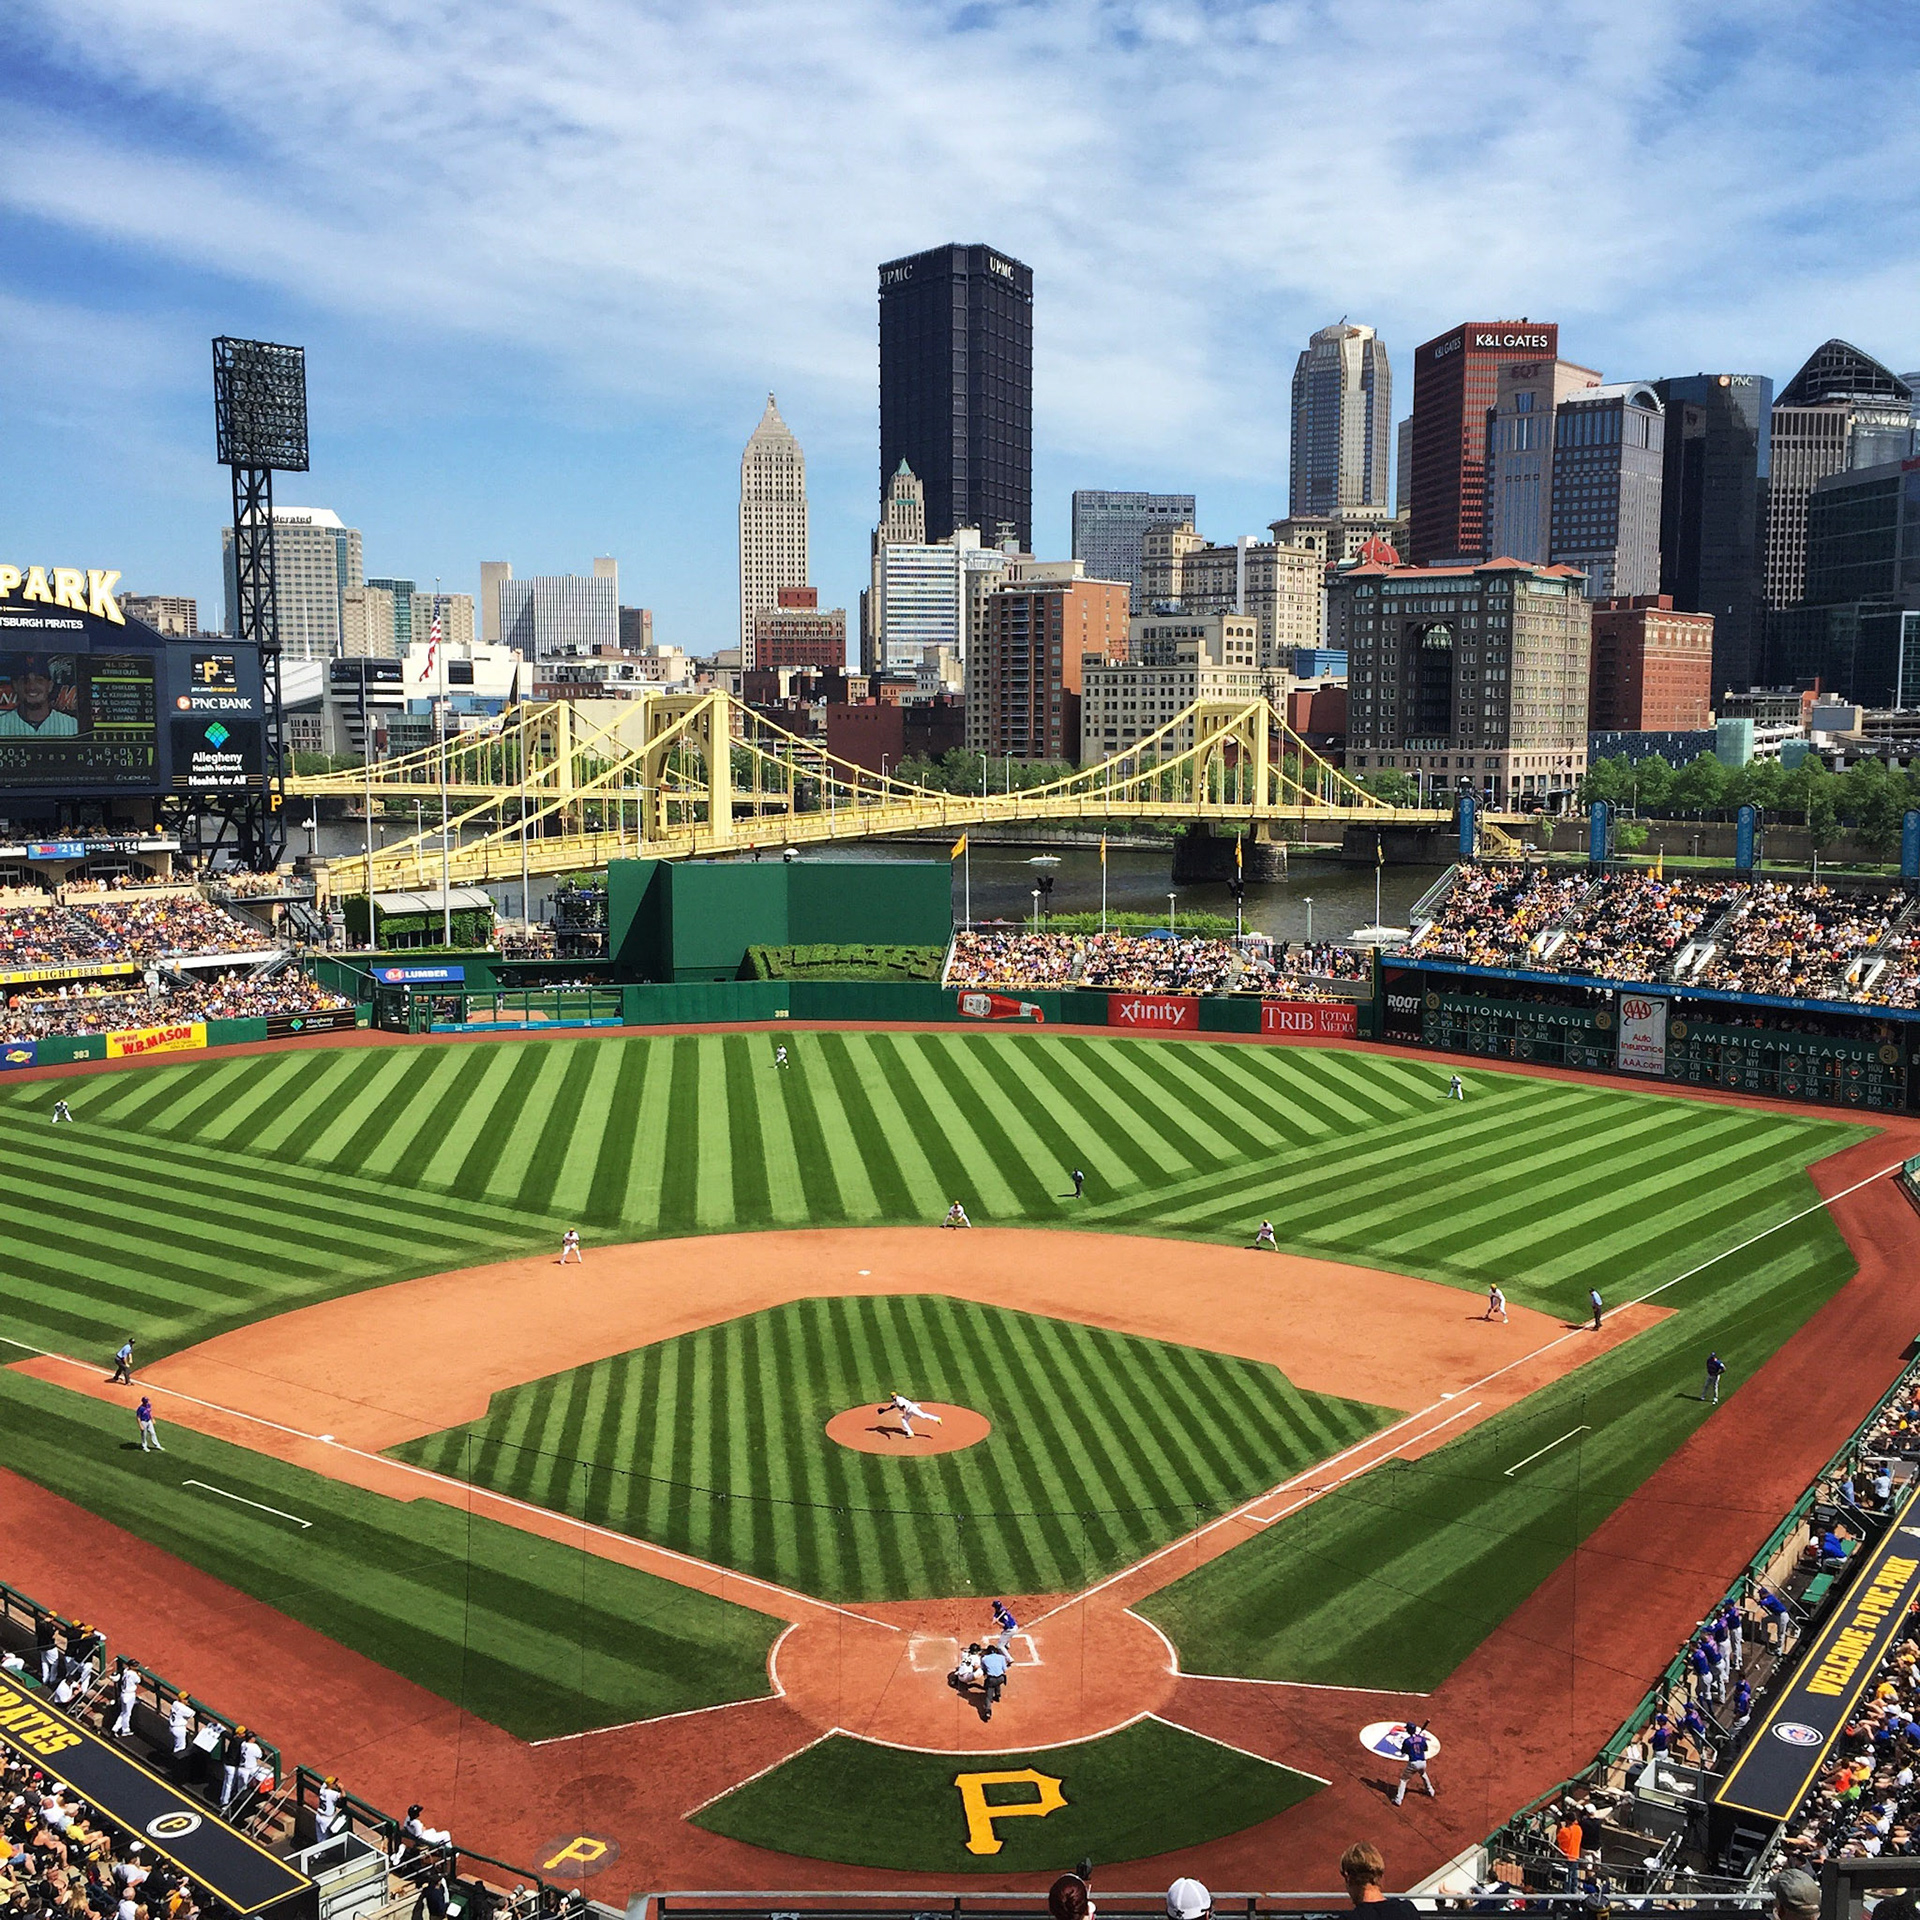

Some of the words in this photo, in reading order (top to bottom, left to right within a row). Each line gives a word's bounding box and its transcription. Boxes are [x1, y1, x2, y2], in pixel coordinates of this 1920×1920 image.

[990, 256, 1015, 281] UPMC
[879, 265, 913, 287] UPMC
[1444, 337, 1462, 355] GATES
[1476, 334, 1501, 347] K&L
[1503, 334, 1549, 348] GATES
[1731, 376, 1754, 387] PNC
[0, 564, 126, 626] PARK
[45, 618, 84, 629] PIRATES
[191, 698, 218, 709] PNC
[219, 697, 252, 710] BANK
[192, 751, 243, 765] Allegheny
[188, 776, 219, 786] Health
[219, 775, 233, 785] for
[233, 775, 247, 785] All
[270, 794, 283, 812] P
[23, 972, 33, 981] IC
[38, 969, 74, 980] LIGHT
[77, 966, 103, 977] BEER
[404, 969, 449, 979] LUMBER
[1387, 994, 1421, 1010] ROOT
[1120, 1000, 1186, 1025] xfinity
[1318, 1009, 1355, 1023] TOTAL
[1443, 1003, 1523, 1020] NATIONAL
[1529, 1012, 1592, 1029] LEAGUE
[1624, 1000, 1651, 1019] AAA
[1262, 1007, 1315, 1030] TRIB
[1320, 1020, 1355, 1034] MEDIA
[1632, 1033, 1652, 1042] Auto
[1621, 1041, 1664, 1054] Insurance
[1692, 1032, 1791, 1052] AMERICAN
[1798, 1045, 1875, 1063] LEAGUE
[1622, 1058, 1663, 1071] AAA.com
[1746, 1058, 1759, 1067] NYY
[1806, 1056, 1821, 1066] OAK
[1867, 1063, 1883, 1074] HOU
[1805, 1077, 1819, 1087] SEA
[1868, 1073, 1883, 1083] DET
[1805, 1087, 1818, 1096] TOR
[1867, 1096, 1882, 1106] BOS
[1873, 1554, 1920, 1590] PARK
[1856, 1585, 1901, 1617] PNC
[1851, 1612, 1882, 1629] TO
[1805, 1626, 1877, 1697] WELCOME
[0, 1686, 83, 1755] RATES
[954, 1767, 1068, 1855] P
[157, 1816, 191, 1830] P
[542, 1835, 609, 1871] P
